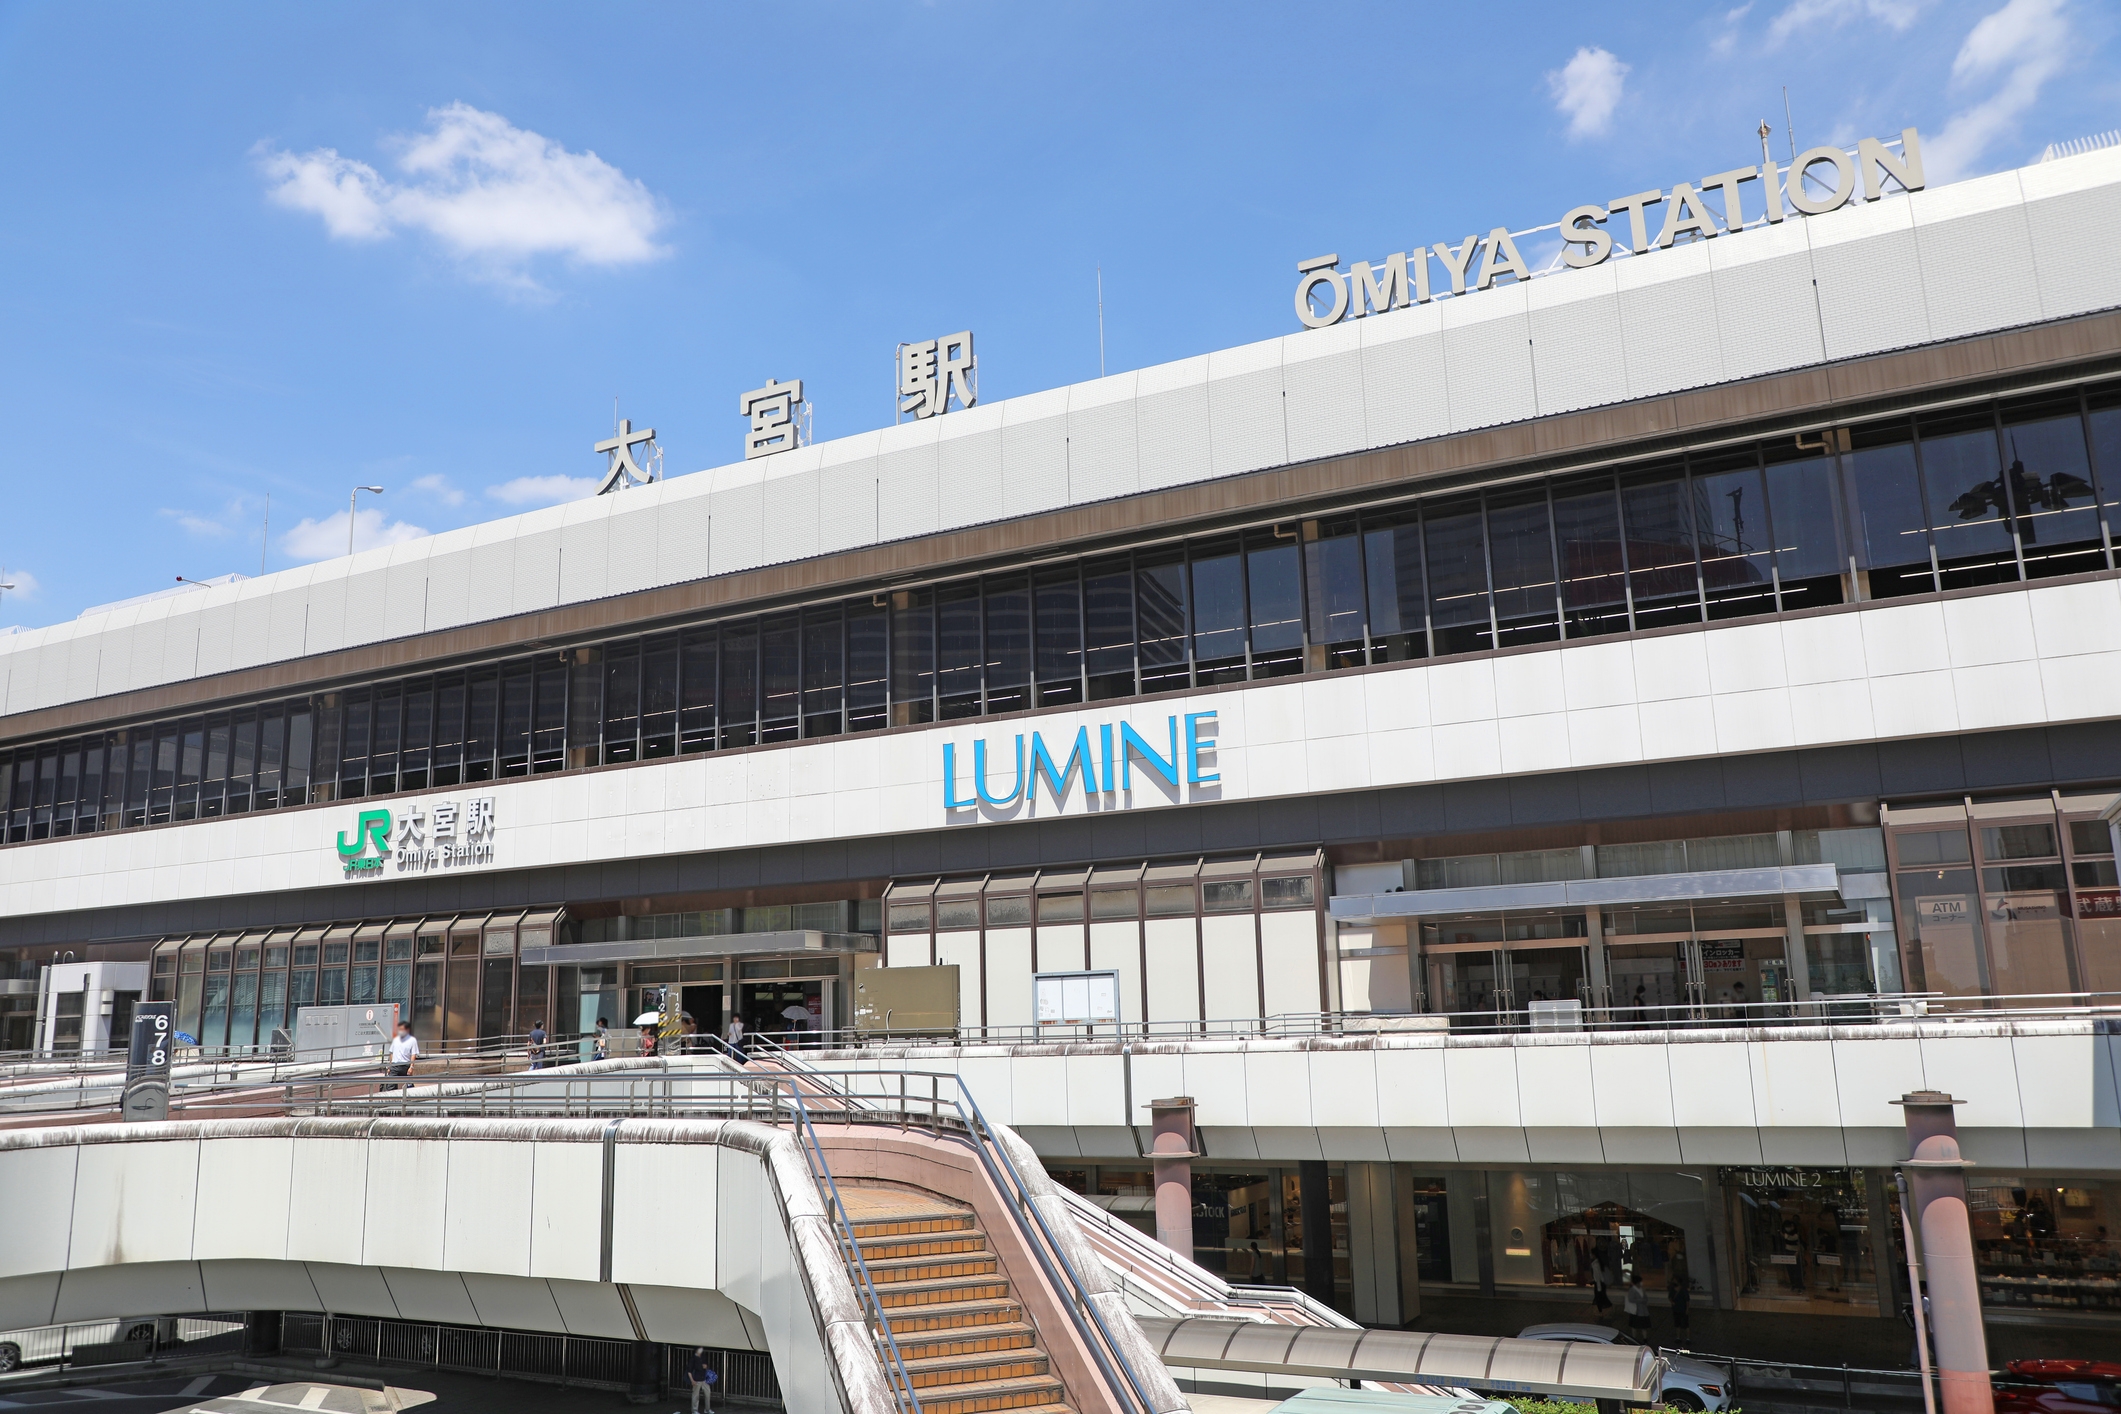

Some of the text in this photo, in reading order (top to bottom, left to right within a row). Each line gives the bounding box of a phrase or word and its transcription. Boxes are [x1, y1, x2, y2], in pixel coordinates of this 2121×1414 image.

[1294, 127, 1925, 328] ŌMIYA STATION
[594, 330, 974, 496] 大宮駅
[943, 710, 1220, 808] LUMINE
[397, 797, 496, 842] 大宮駅
[337, 808, 392, 856] JR
[443, 840, 494, 859] Station
[1932, 903, 1961, 913] ATM
[1932, 914, 1965, 922] コーナー
[660, 1003, 665, 1012] 2
[675, 1003, 680, 1012] 2
[155, 1014, 169, 1031] 6
[154, 1032, 167, 1048] 7
[151, 1049, 166, 1066] 8
[1745, 1172, 1822, 1187] LUMINE 2
